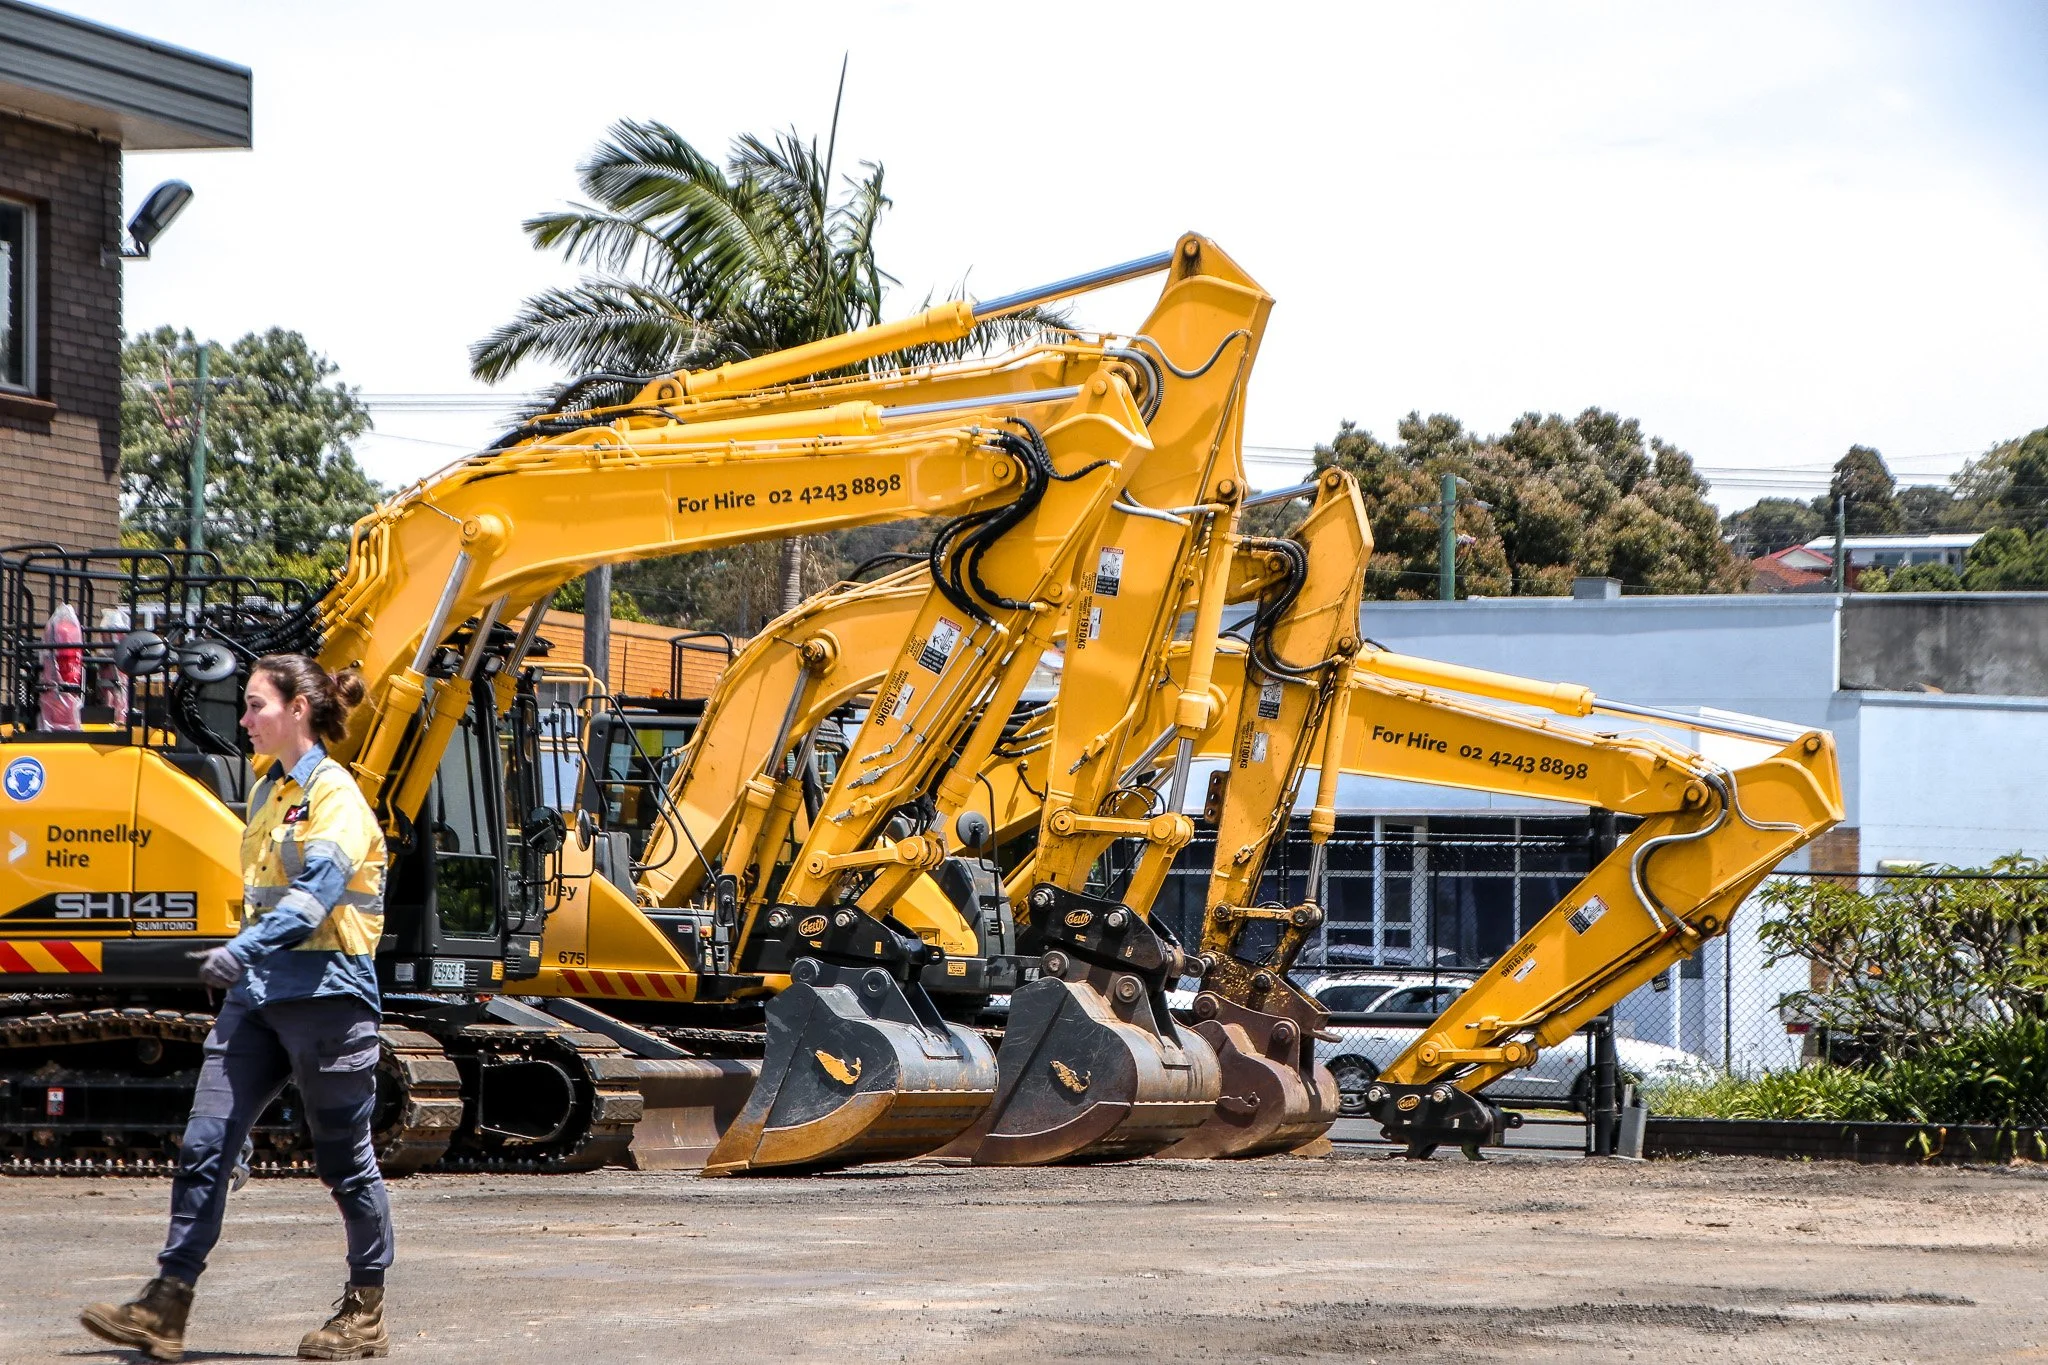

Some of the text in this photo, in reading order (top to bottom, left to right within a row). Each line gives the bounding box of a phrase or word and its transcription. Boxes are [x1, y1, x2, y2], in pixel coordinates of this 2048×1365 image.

[677, 473, 901, 514] For Hire 02 4243 8898
[875, 692, 898, 727] 1330KG
[1371, 725, 1589, 781] For Hire 02 4243 8898
[47, 824, 151, 848] Donnelley
[46, 848, 90, 868] Hire
[55, 892, 195, 919] SH145
[135, 921, 194, 931] SUMITOMO
[558, 951, 585, 966] 675
